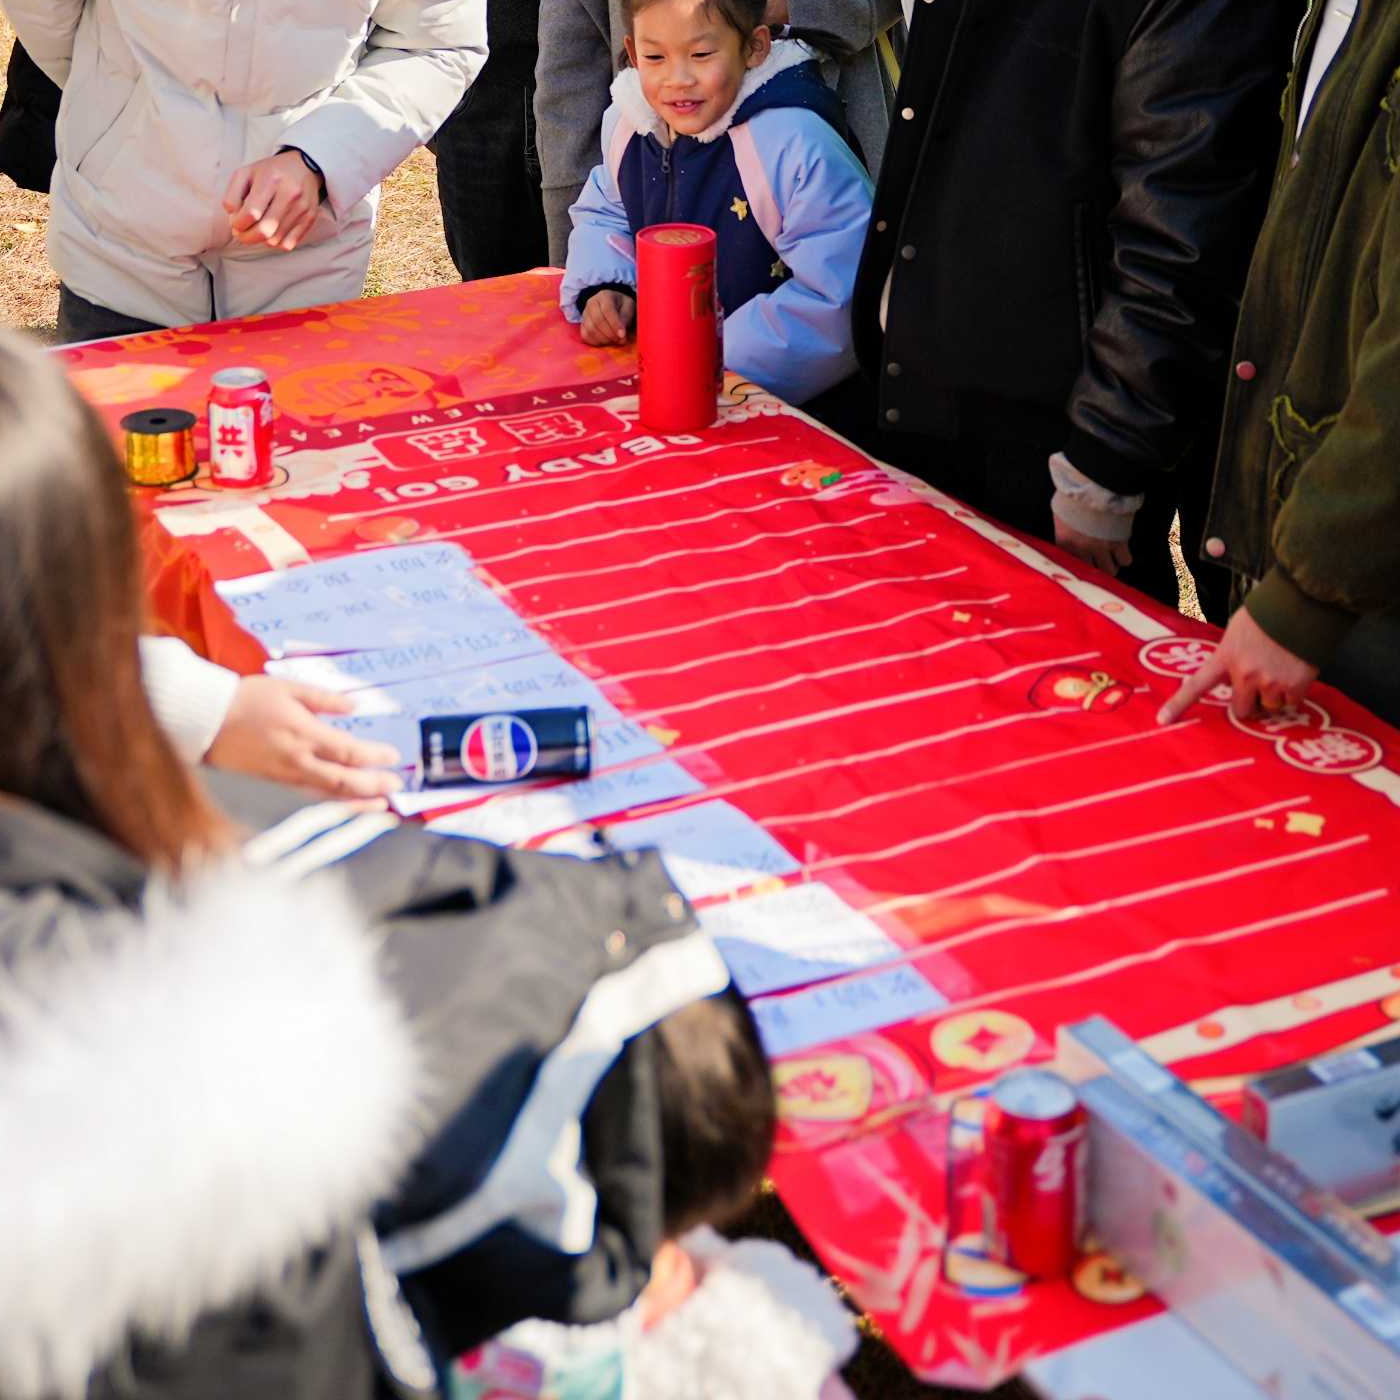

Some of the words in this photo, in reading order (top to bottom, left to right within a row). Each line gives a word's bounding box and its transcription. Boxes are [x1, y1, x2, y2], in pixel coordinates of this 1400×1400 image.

[410, 401, 496, 426] NEW
[503, 431, 703, 484] READY
[372, 473, 481, 502] GO!
